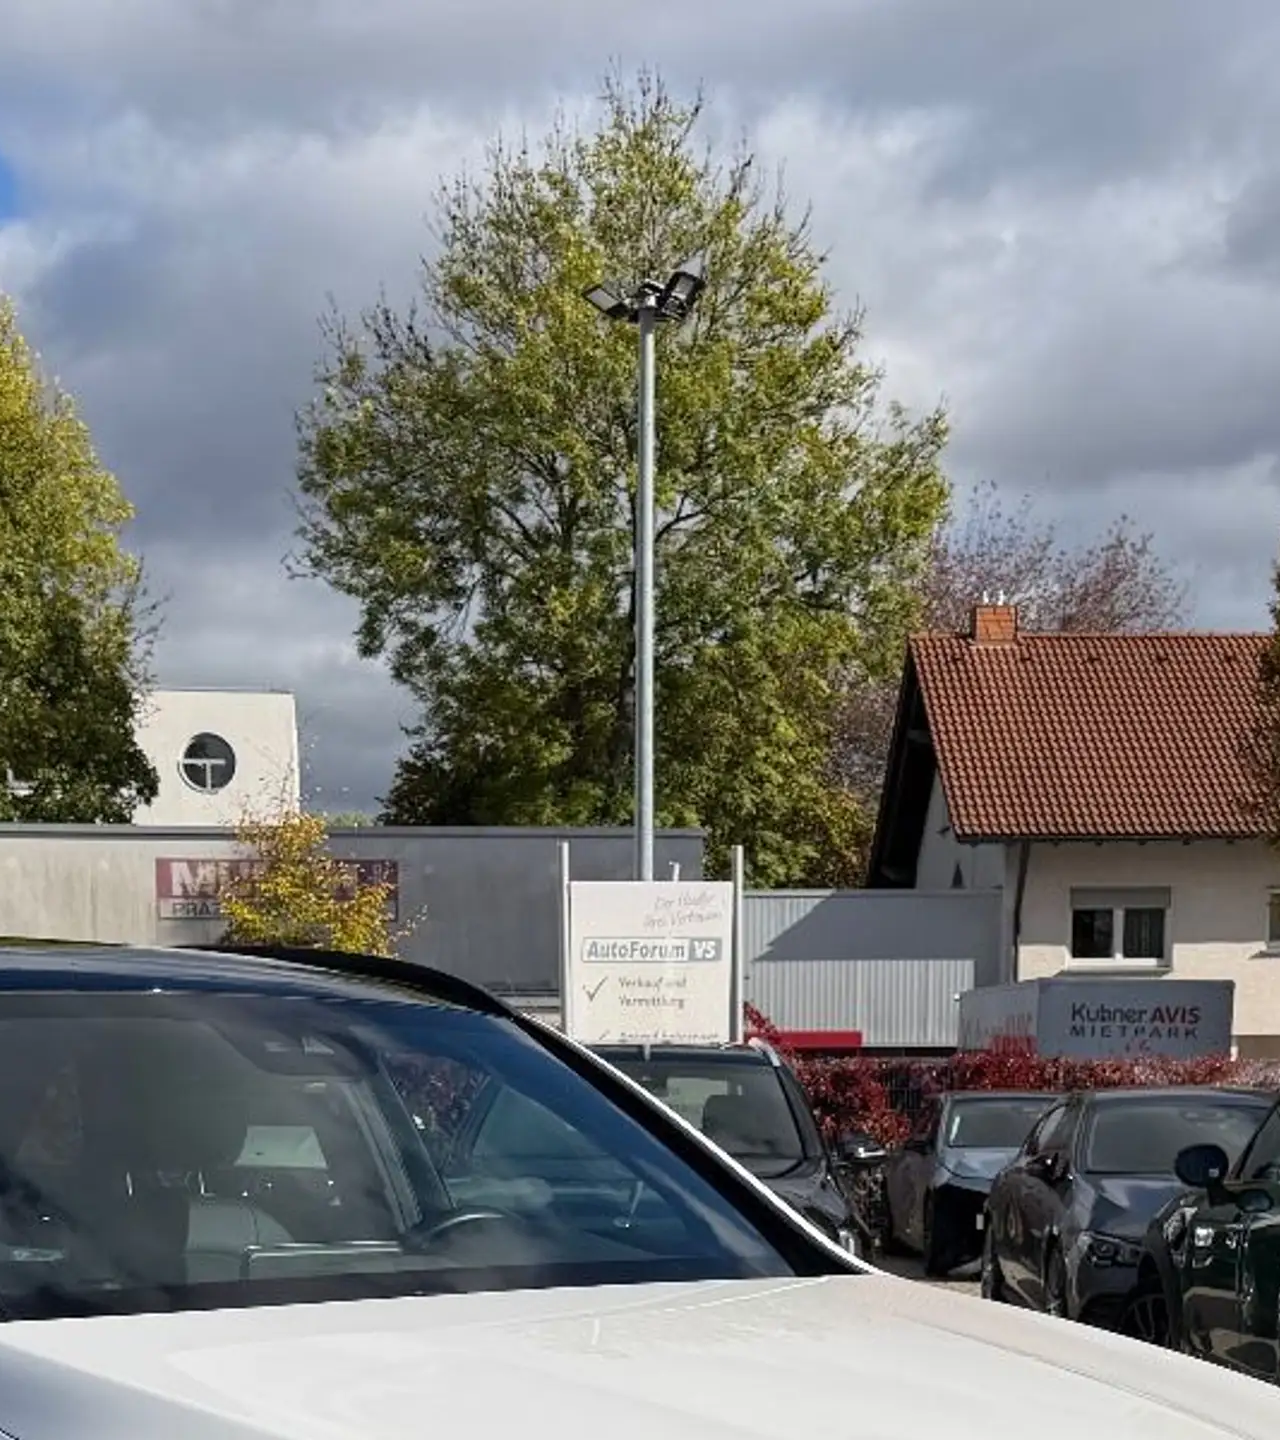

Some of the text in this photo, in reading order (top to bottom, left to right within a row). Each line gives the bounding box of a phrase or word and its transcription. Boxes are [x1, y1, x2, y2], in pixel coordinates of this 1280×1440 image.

[587, 941, 716, 958] AutoForum VS
[1150, 1005, 1201, 1024] AVIS
[1070, 1025, 1198, 1040] MIETPARK
